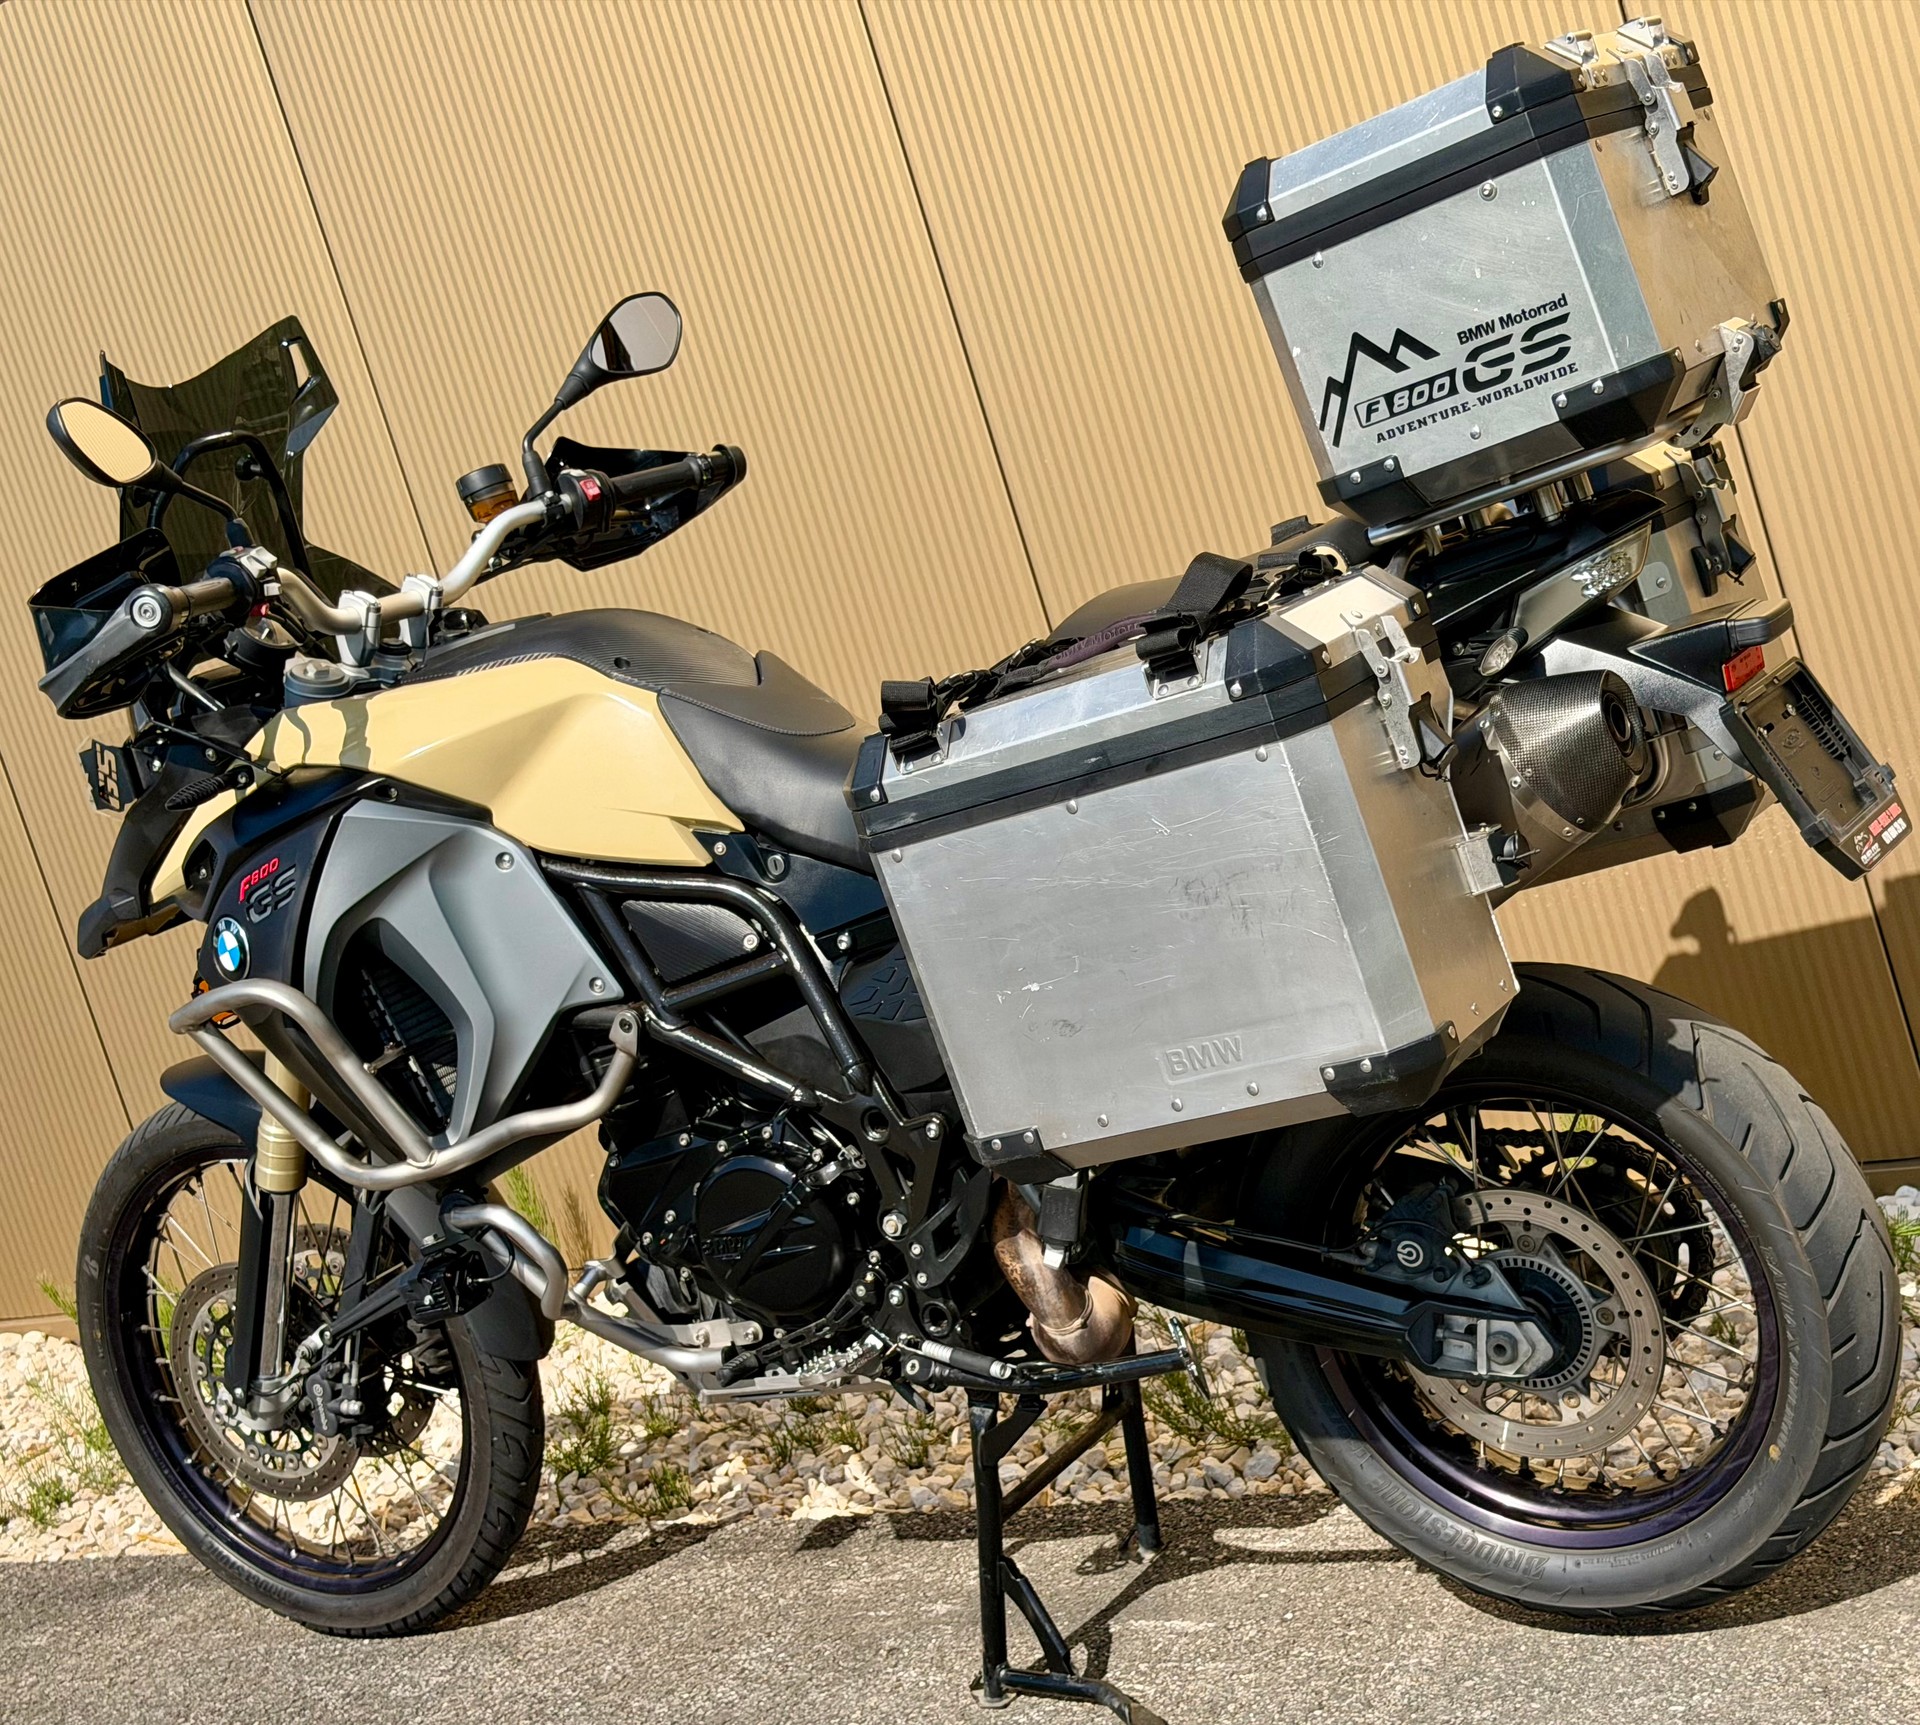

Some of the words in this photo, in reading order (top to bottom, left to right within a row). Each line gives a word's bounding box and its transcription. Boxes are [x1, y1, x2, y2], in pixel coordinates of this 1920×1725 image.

[1456, 319, 1496, 346] BMW
[1498, 292, 1569, 330] Motorrad
[1365, 399, 1382, 424] F
[1392, 375, 1450, 414] 800
[1462, 311, 1573, 393] GS
[238, 857, 279, 904] F800
[246, 864, 297, 924] GS
[1165, 1034, 1243, 1076] BMW
[1366, 1476, 1551, 1581] BRIDGESTONE
